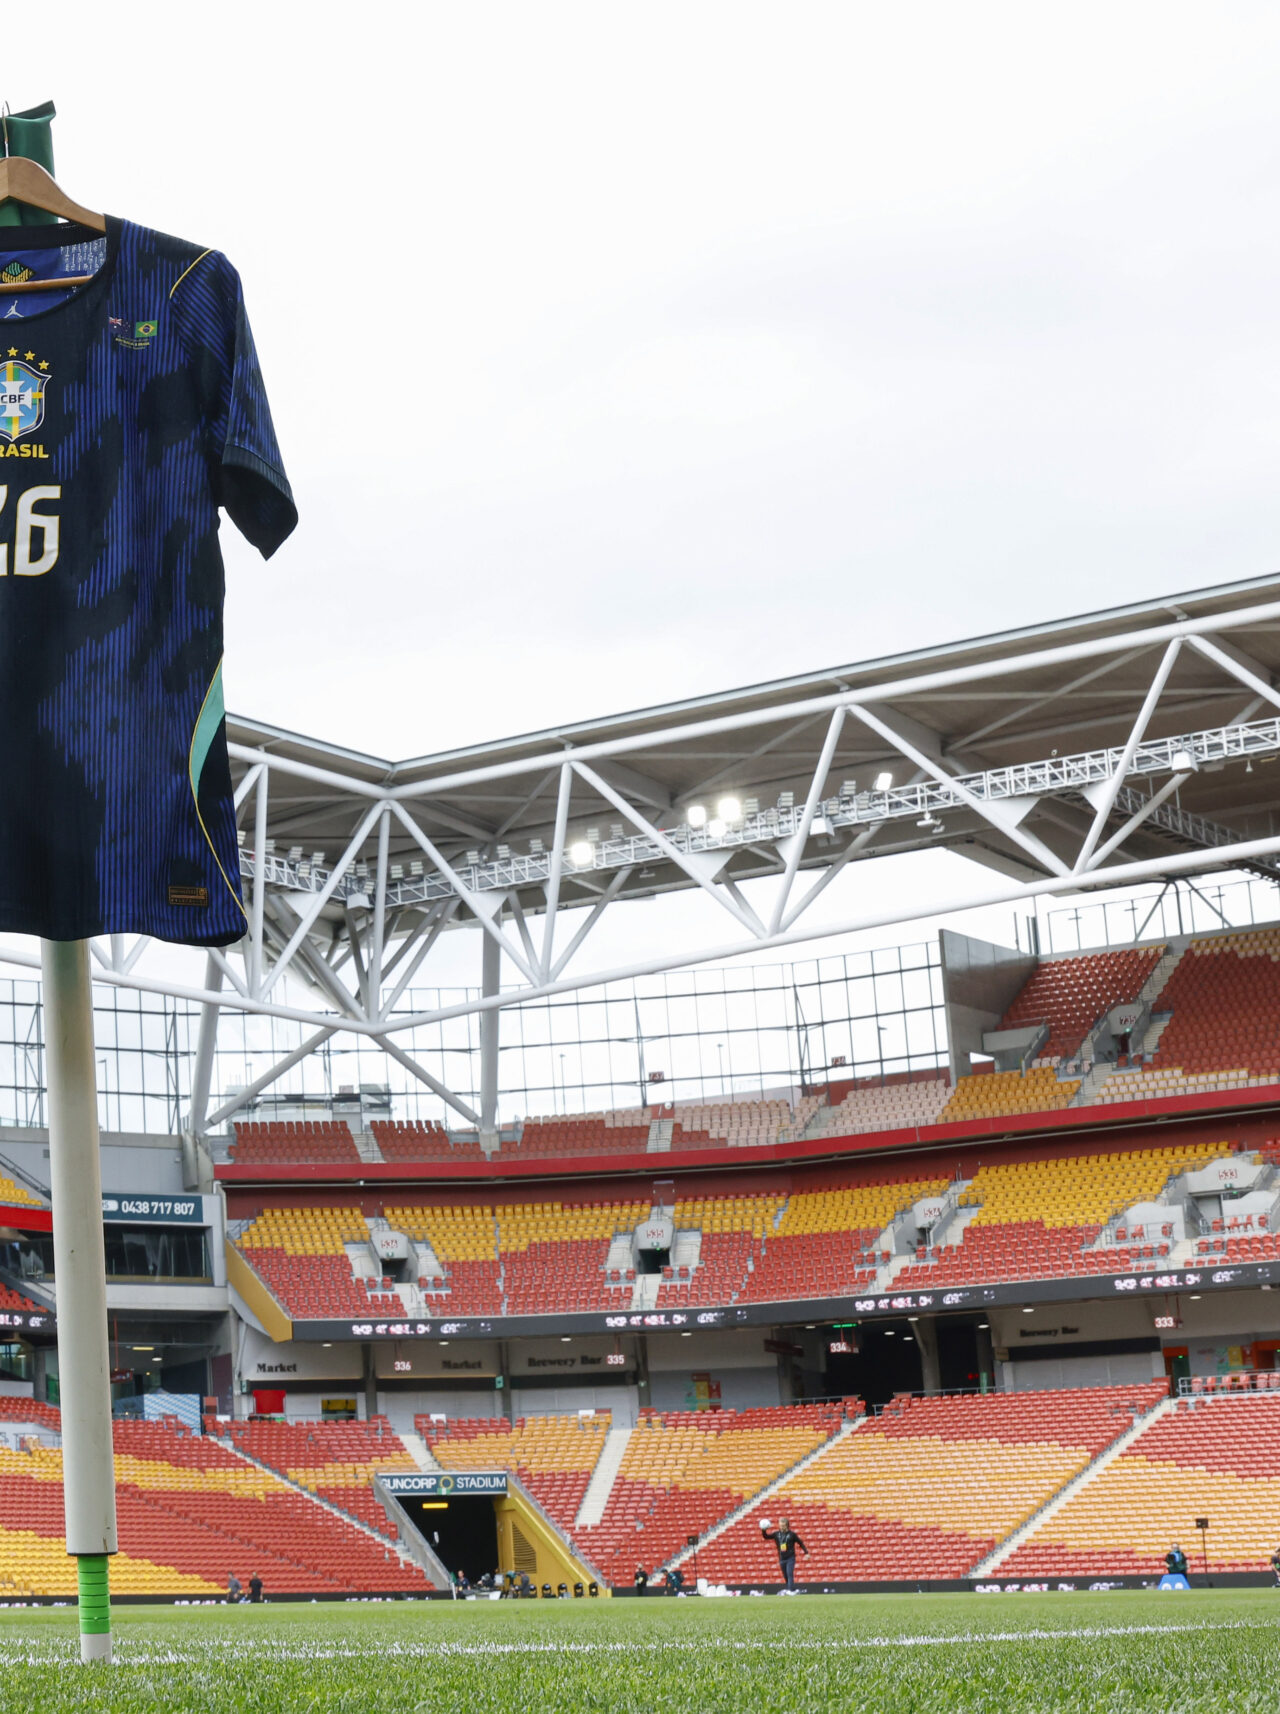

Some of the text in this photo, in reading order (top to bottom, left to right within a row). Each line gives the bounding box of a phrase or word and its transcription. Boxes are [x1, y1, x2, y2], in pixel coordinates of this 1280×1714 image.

[1, 394, 25, 404] CBF
[1219, 1168, 1238, 1180] 533
[121, 1200, 150, 1214] 0438
[151, 1202, 172, 1215] 717
[174, 1203, 195, 1216] 807
[647, 1229, 664, 1239] 535
[1155, 1317, 1174, 1328] 333
[831, 1342, 847, 1353] 334
[441, 1360, 483, 1370] Market
[528, 1355, 602, 1367] Brewery Bar
[607, 1354, 625, 1365] 335
[256, 1363, 297, 1373] Market
[394, 1361, 412, 1371] 336
[381, 1475, 506, 1490] SUNCORP STADIUM
